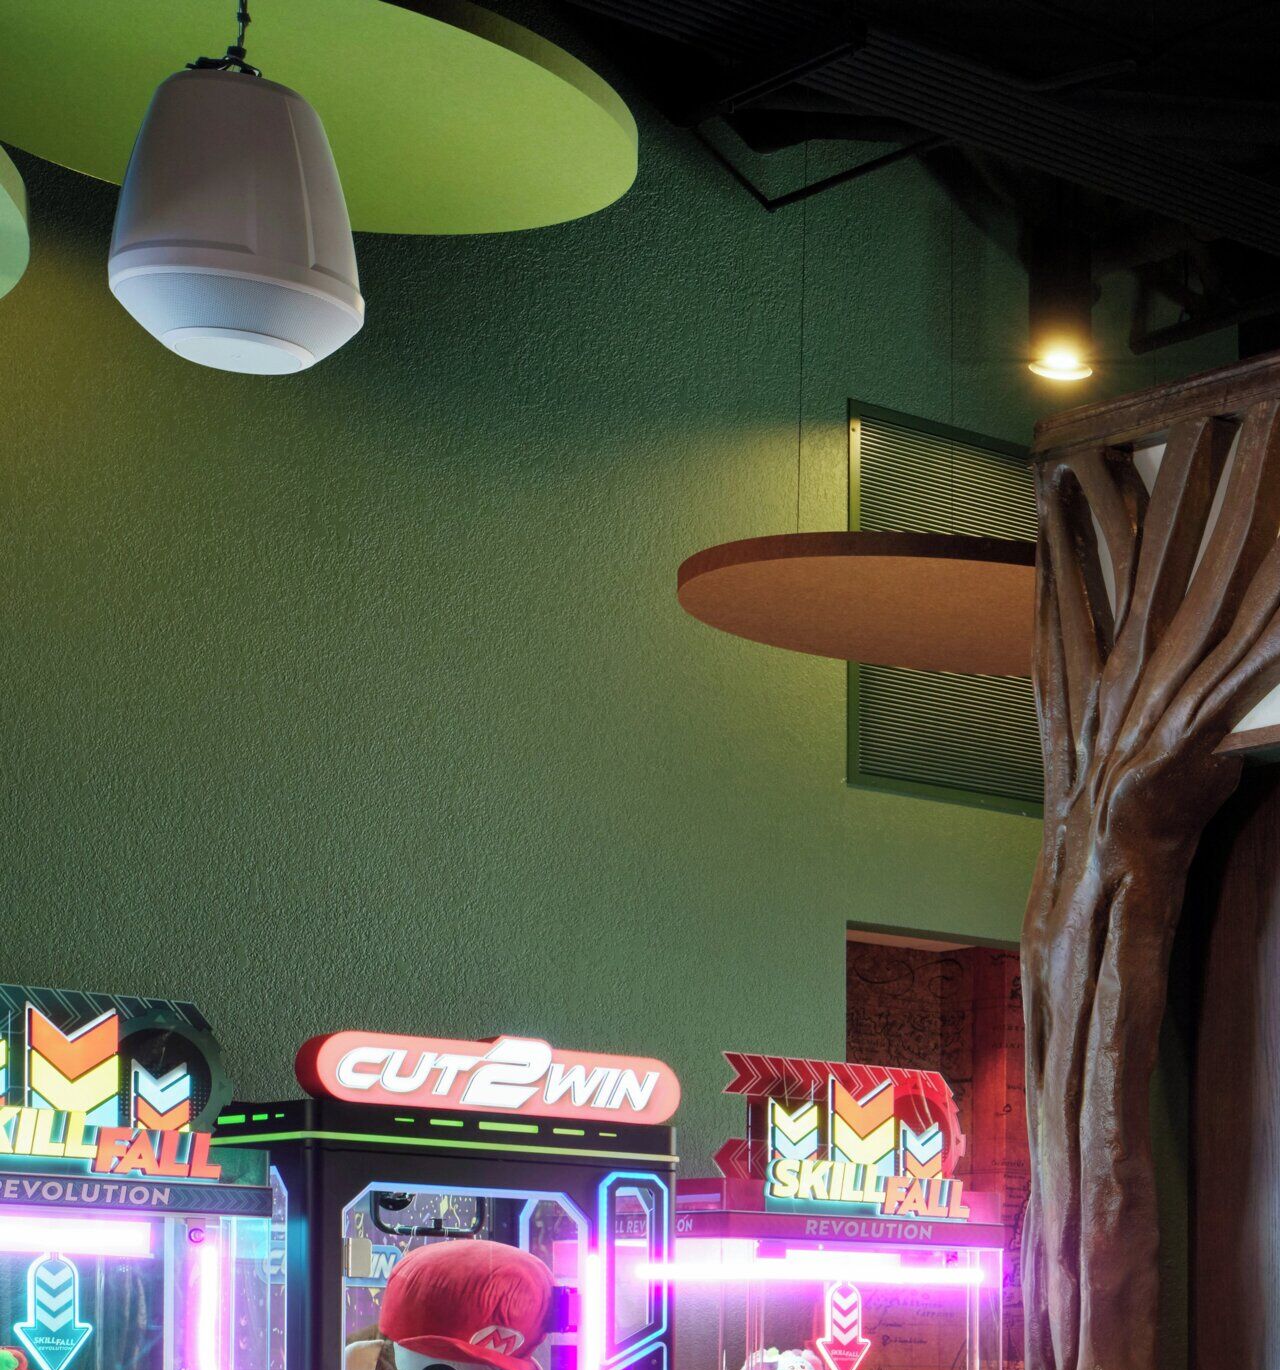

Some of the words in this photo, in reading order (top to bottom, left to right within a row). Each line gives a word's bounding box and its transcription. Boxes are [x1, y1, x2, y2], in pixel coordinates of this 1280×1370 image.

[337, 1038, 660, 1111] CUT2WIN
[0, 1179, 172, 1206] EVOLUTION
[805, 1219, 933, 1240] REVOLUTION
